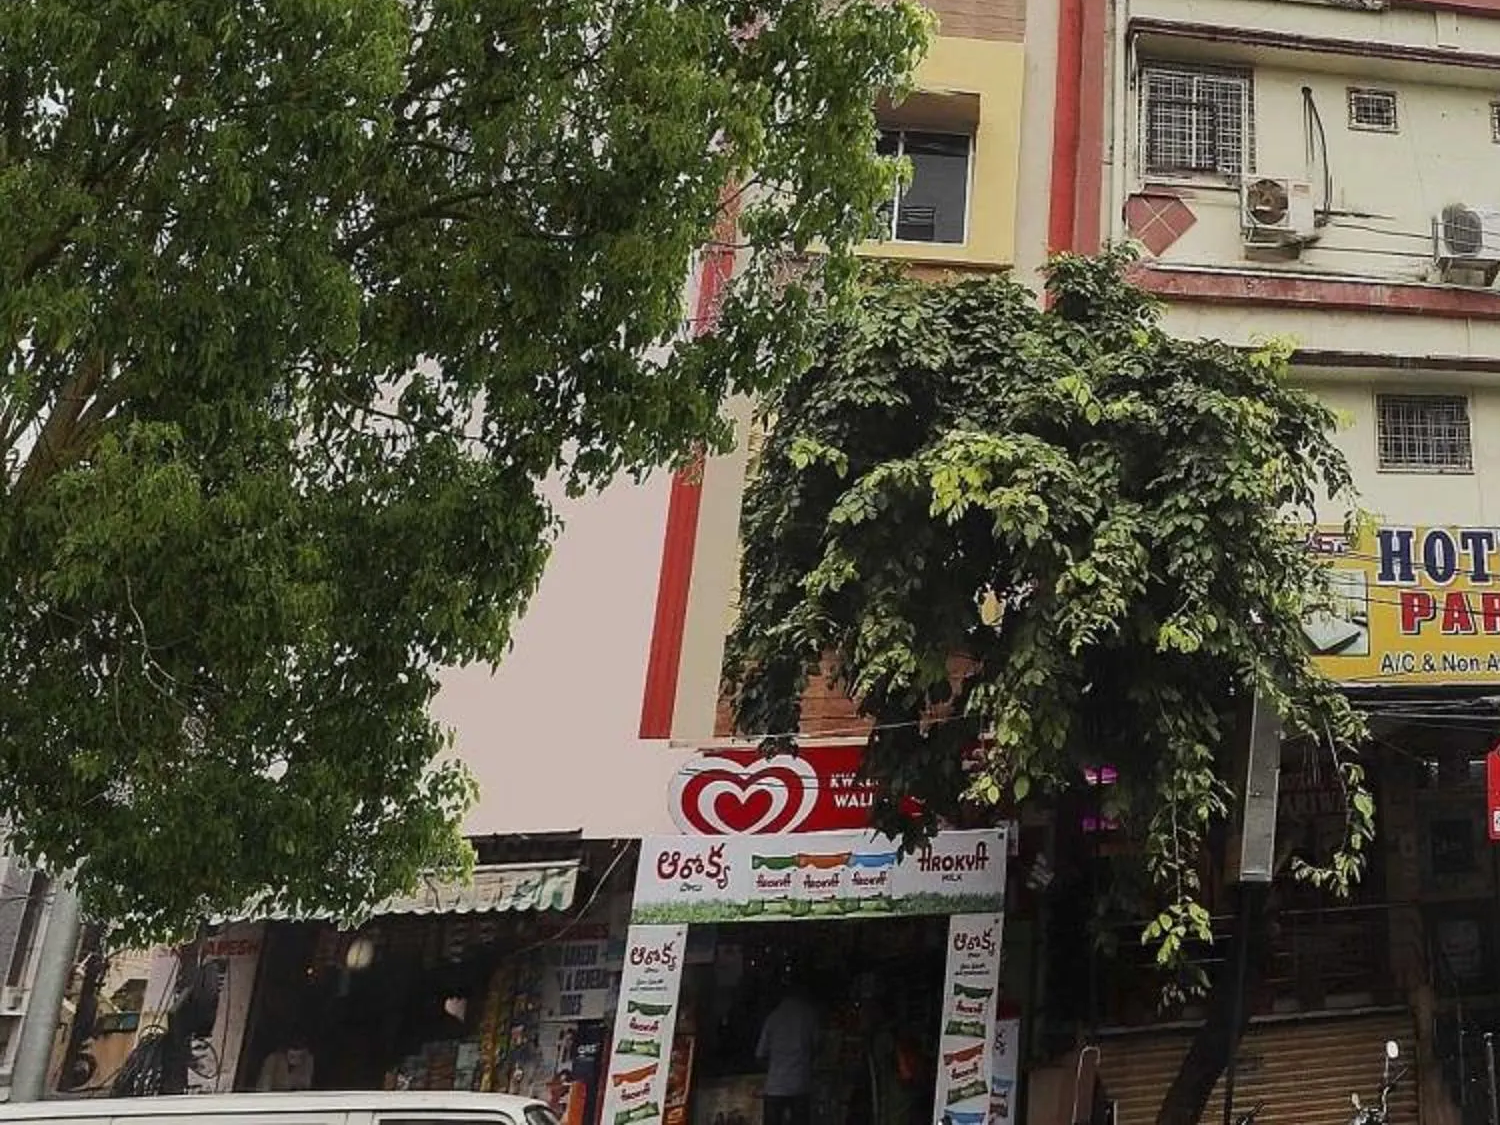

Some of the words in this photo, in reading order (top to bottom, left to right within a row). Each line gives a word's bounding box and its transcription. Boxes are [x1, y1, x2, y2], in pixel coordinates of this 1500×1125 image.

[1381, 654, 1416, 673] A/C
[1422, 654, 1437, 673] &
[1443, 654, 1481, 672] Non
[918, 842, 989, 872] AROKYA
